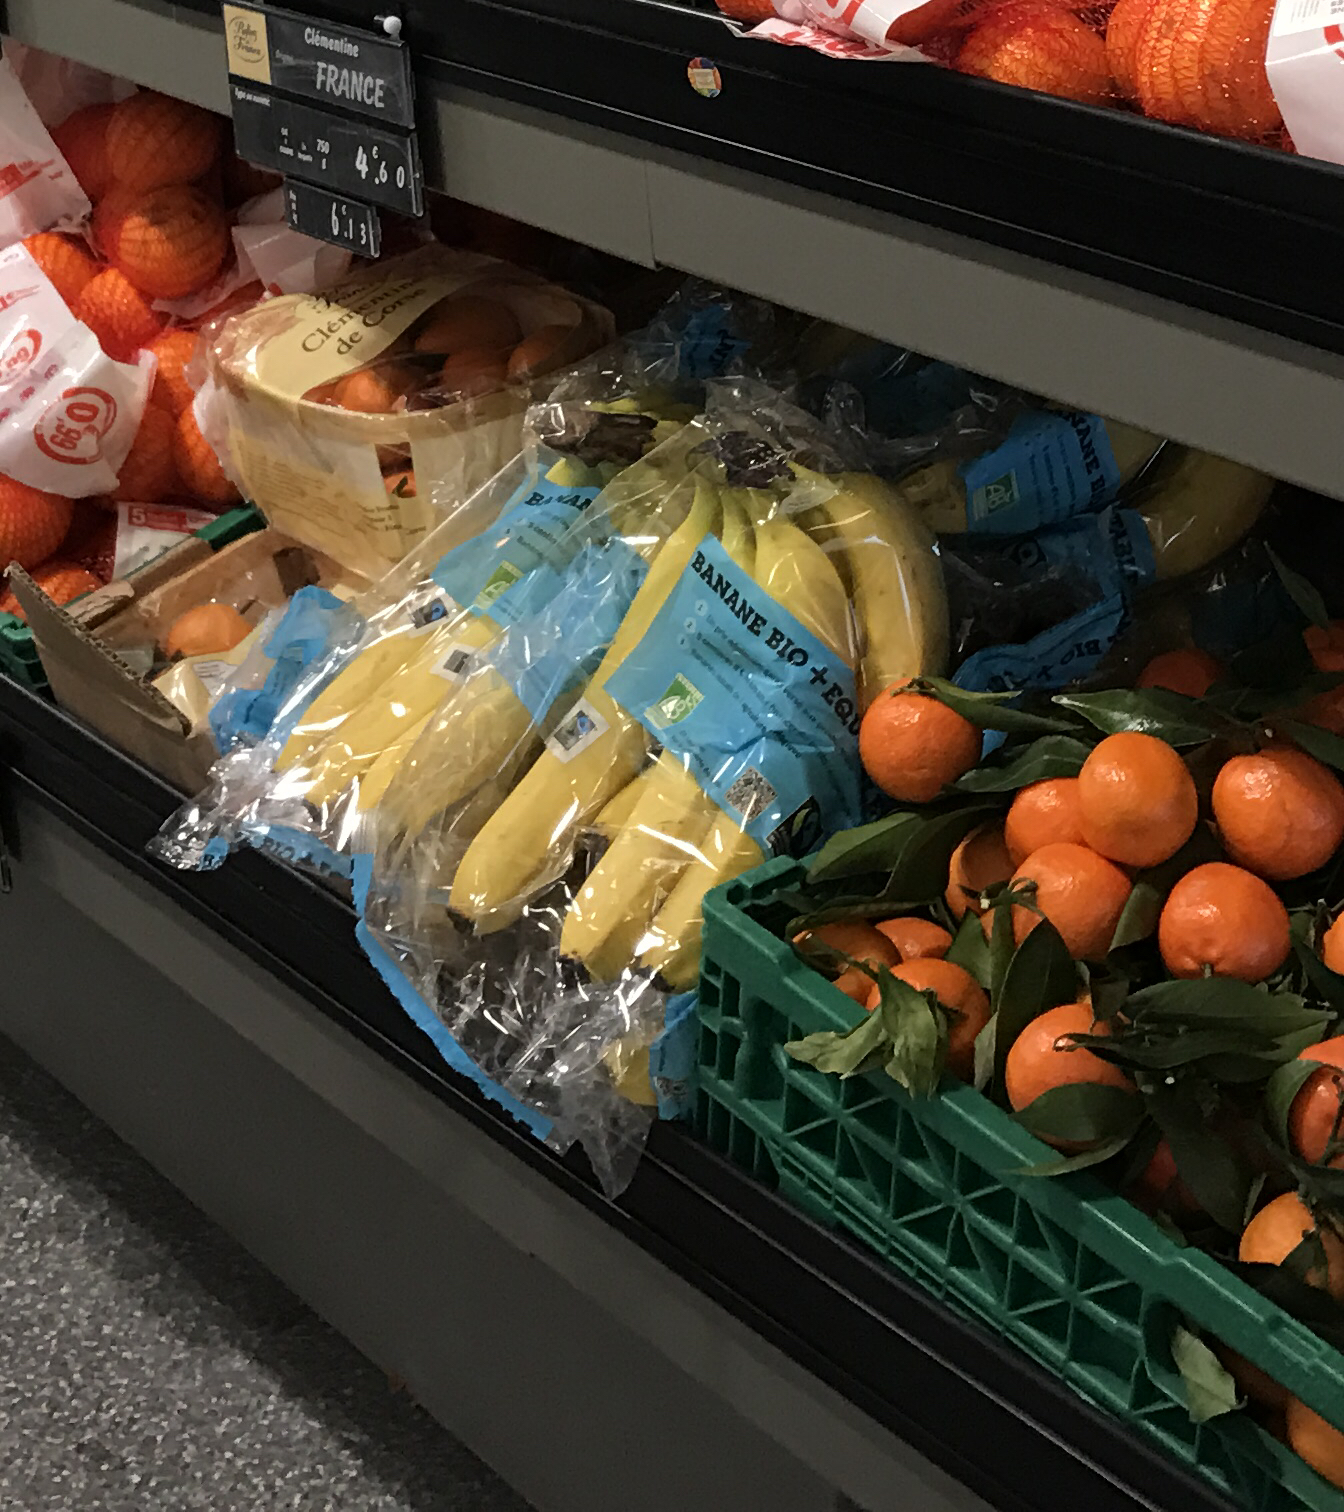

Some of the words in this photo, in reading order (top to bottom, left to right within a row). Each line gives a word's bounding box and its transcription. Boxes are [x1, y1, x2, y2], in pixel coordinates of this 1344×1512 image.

[304, 26, 360, 58] Clémentine
[315, 61, 385, 108] FRANCE
[336, 329, 364, 356] de
[131, 508, 147, 526] 5
[690, 550, 769, 638] BANANE
[764, 626, 810, 668] BIO
[809, 665, 829, 686] +
